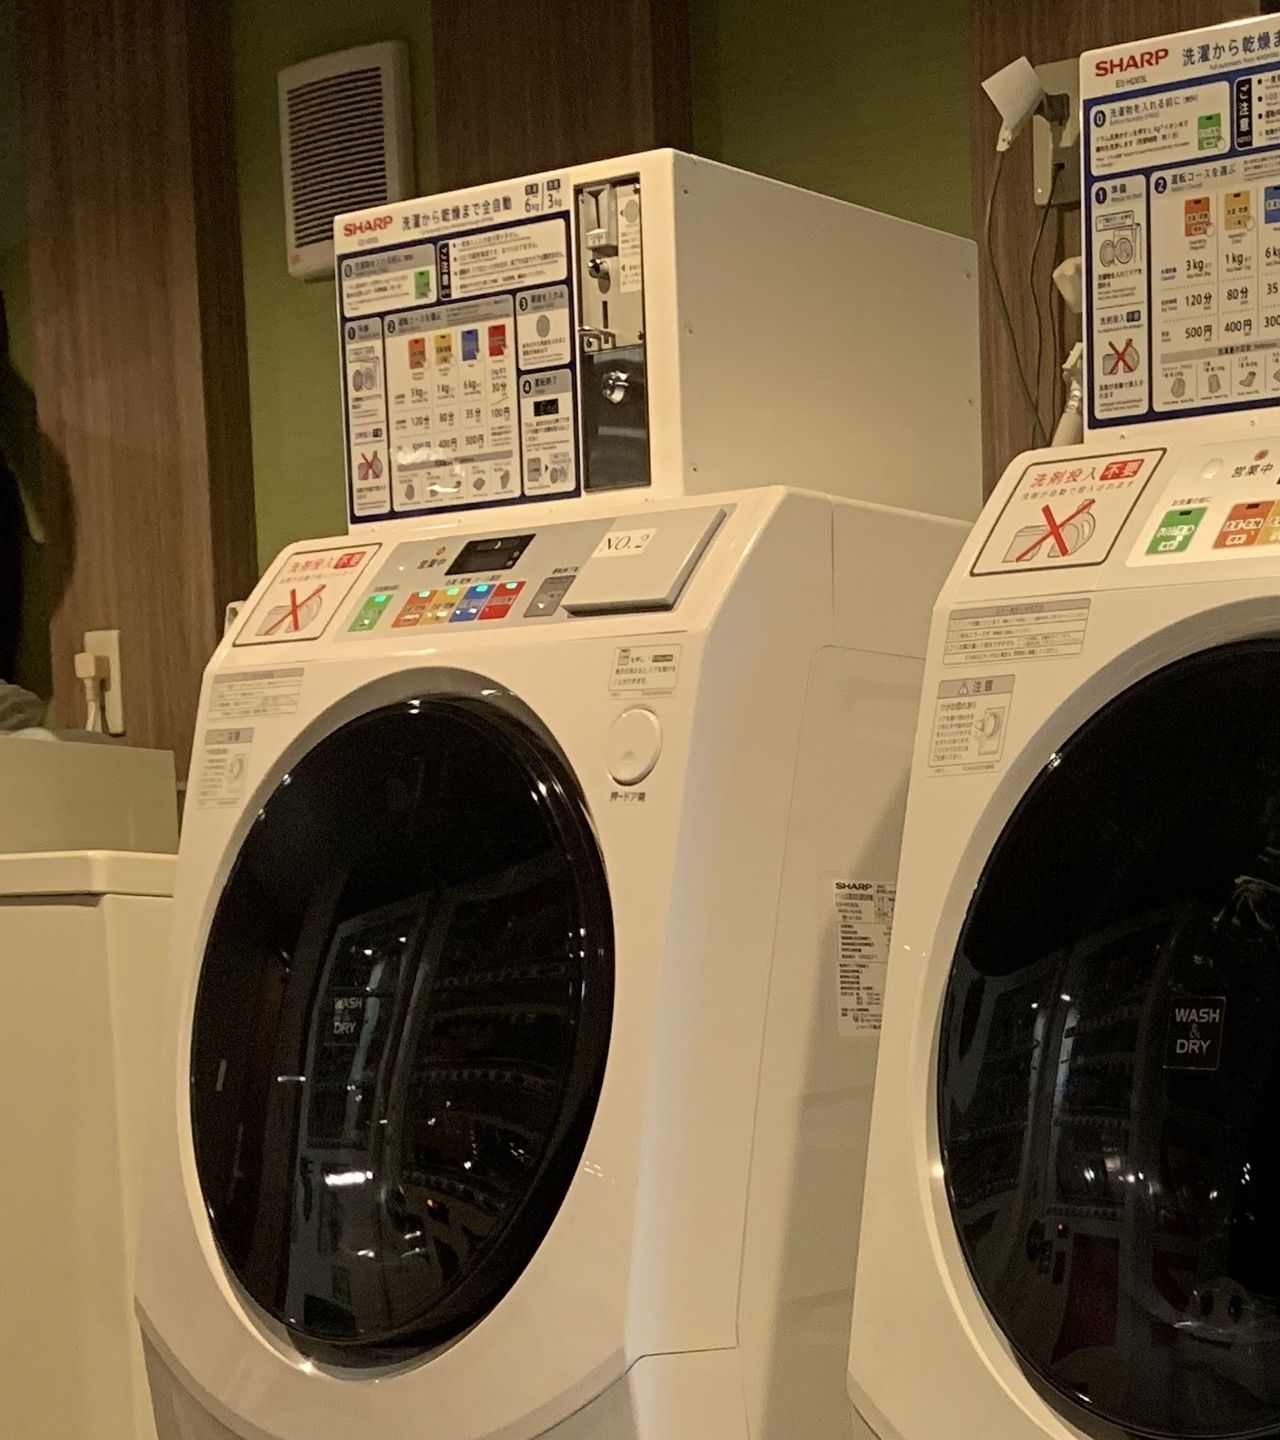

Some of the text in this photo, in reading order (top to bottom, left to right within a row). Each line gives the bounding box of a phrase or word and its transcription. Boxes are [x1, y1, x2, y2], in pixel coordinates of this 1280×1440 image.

[1095, 48, 1169, 77] SHARP
[1171, 163, 1236, 186] 運転コースを選ぶ
[402, 195, 513, 232] 洗濯から乾燥まで全自動
[343, 215, 393, 238] SHARP
[1186, 259, 1204, 272] 3kg
[1225, 253, 1244, 265] 1kg
[1185, 293, 1213, 307] 120分
[1226, 287, 1249, 301] 80分
[1185, 325, 1213, 340] 500円
[1224, 319, 1252, 333] 400円
[1030, 467, 1096, 488] 洗剤投入
[1231, 463, 1274, 479] 営業中
[836, 882, 872, 891] SHARP
[1175, 1008, 1220, 1023] WASH
[334, 1021, 357, 1034] DRY
[1176, 1039, 1212, 1054] DRY
